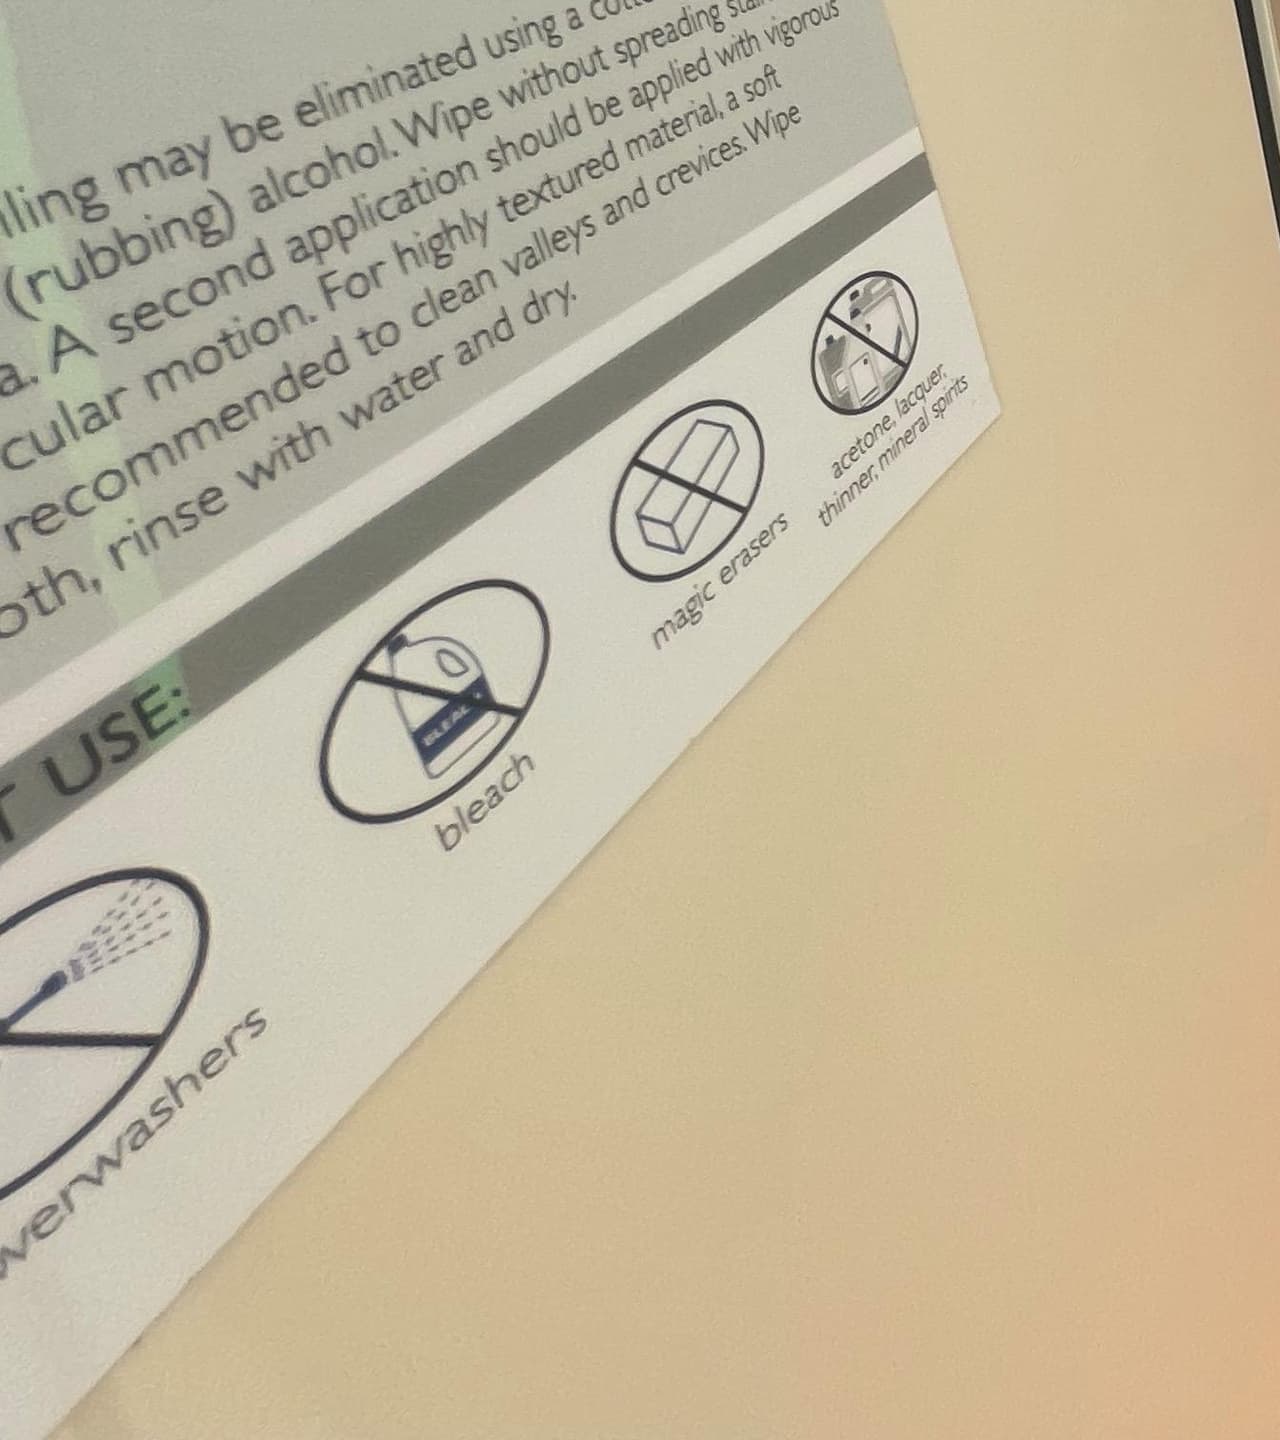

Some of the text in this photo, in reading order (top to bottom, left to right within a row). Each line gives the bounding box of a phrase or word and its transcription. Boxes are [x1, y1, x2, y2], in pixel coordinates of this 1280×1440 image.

[5, 187, 235, 322] (rubbing)
[249, 125, 399, 213] alcohol.
[391, 97, 494, 148] Wipe
[497, 44, 610, 109] without
[613, 3, 725, 68] spreading
[115, 135, 210, 195] may
[221, 114, 284, 154] be
[294, 33, 477, 128] eliminated
[483, 14, 564, 61] using
[566, 7, 584, 31] a
[50, 323, 98, 375] A
[108, 236, 275, 344] second
[286, 160, 480, 265] application
[485, 103, 582, 173] should
[585, 95, 624, 127] be
[628, 46, 712, 112] applied
[714, 28, 762, 67] with
[143, 301, 318, 401] motion.
[316, 261, 387, 311] For
[390, 208, 488, 275] highly
[496, 139, 620, 222] textured
[624, 92, 725, 160] material,
[726, 88, 740, 112] a
[743, 63, 782, 103] soft
[3, 103, 803, 552] recommended to clean valleys and crevices. Wipe
[107, 484, 230, 572] rinse
[235, 420, 333, 491] with
[337, 353, 445, 430] water
[454, 305, 515, 366] and
[522, 280, 577, 325] dry.
[817, 374, 969, 528] thinner, mineral spirits
[830, 410, 897, 479] acetone,
[650, 511, 790, 651] magic erasers
[40, 683, 190, 796] USE:
[434, 754, 535, 852] bleach
